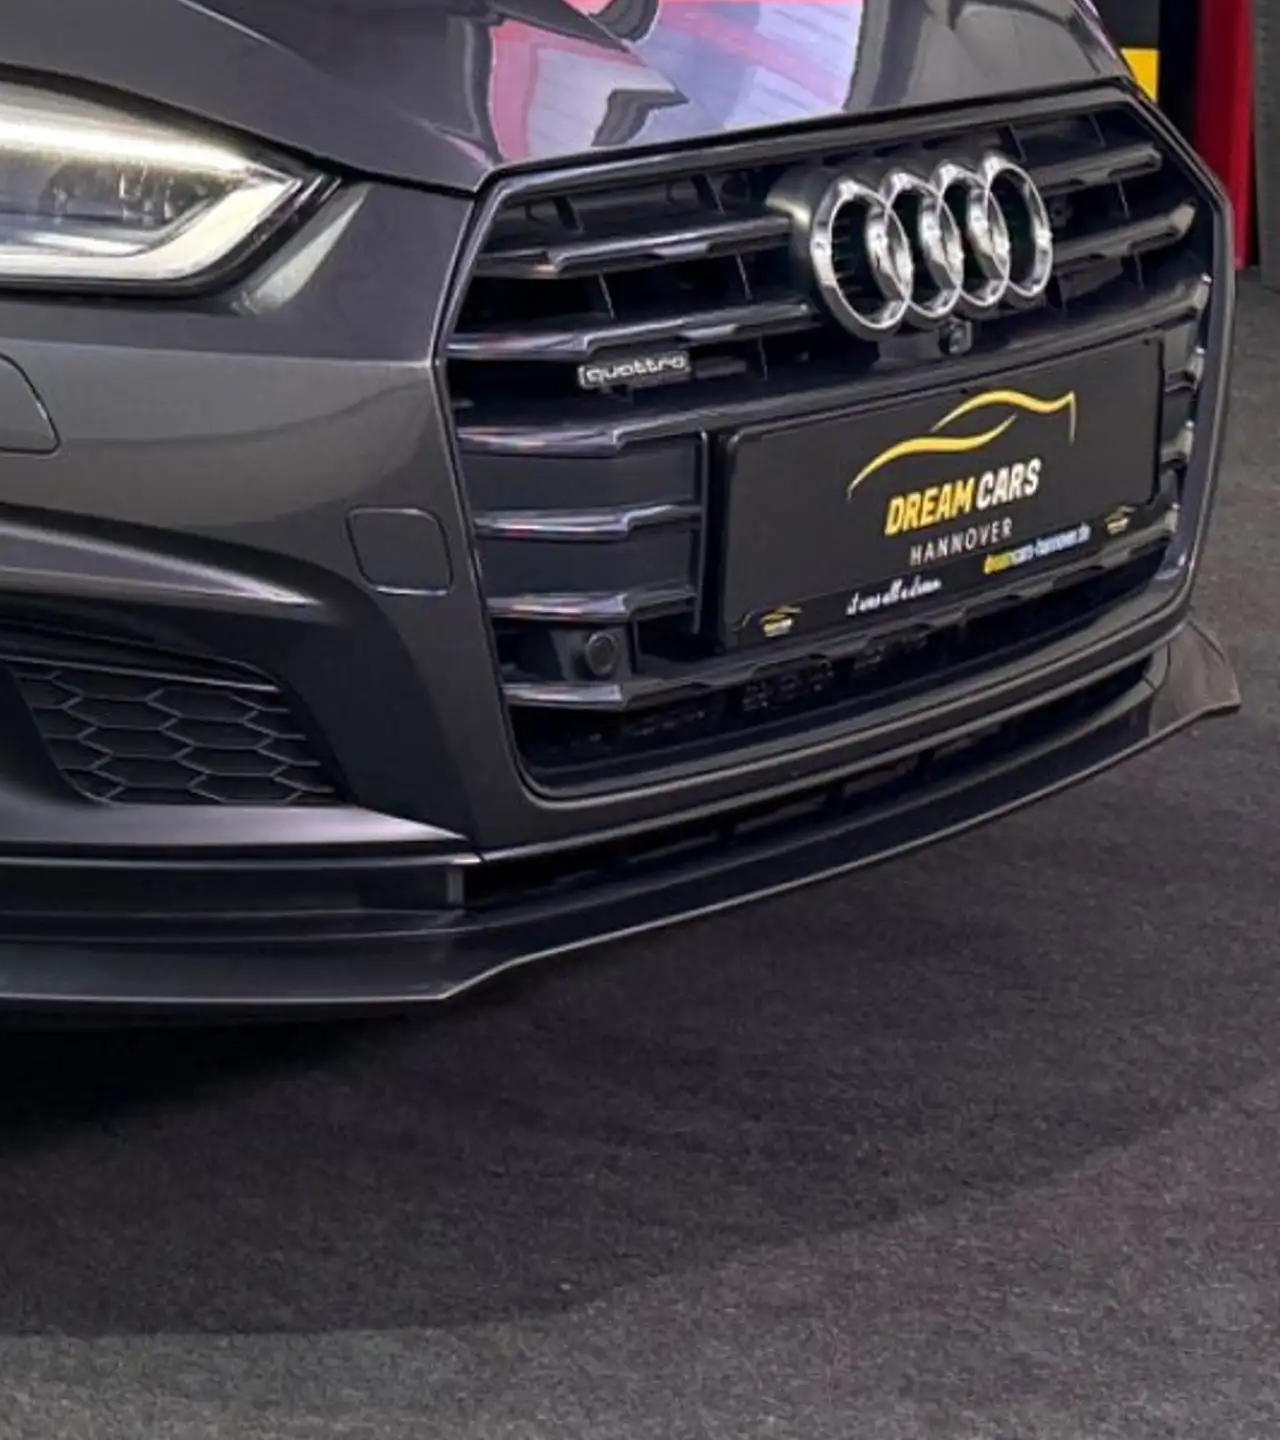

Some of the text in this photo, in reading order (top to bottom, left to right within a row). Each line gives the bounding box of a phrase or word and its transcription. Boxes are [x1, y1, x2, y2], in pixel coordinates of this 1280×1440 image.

[584, 354, 687, 387] quattro
[883, 457, 1042, 537] DREAM CARS
[909, 517, 1014, 567] HANNOVER
